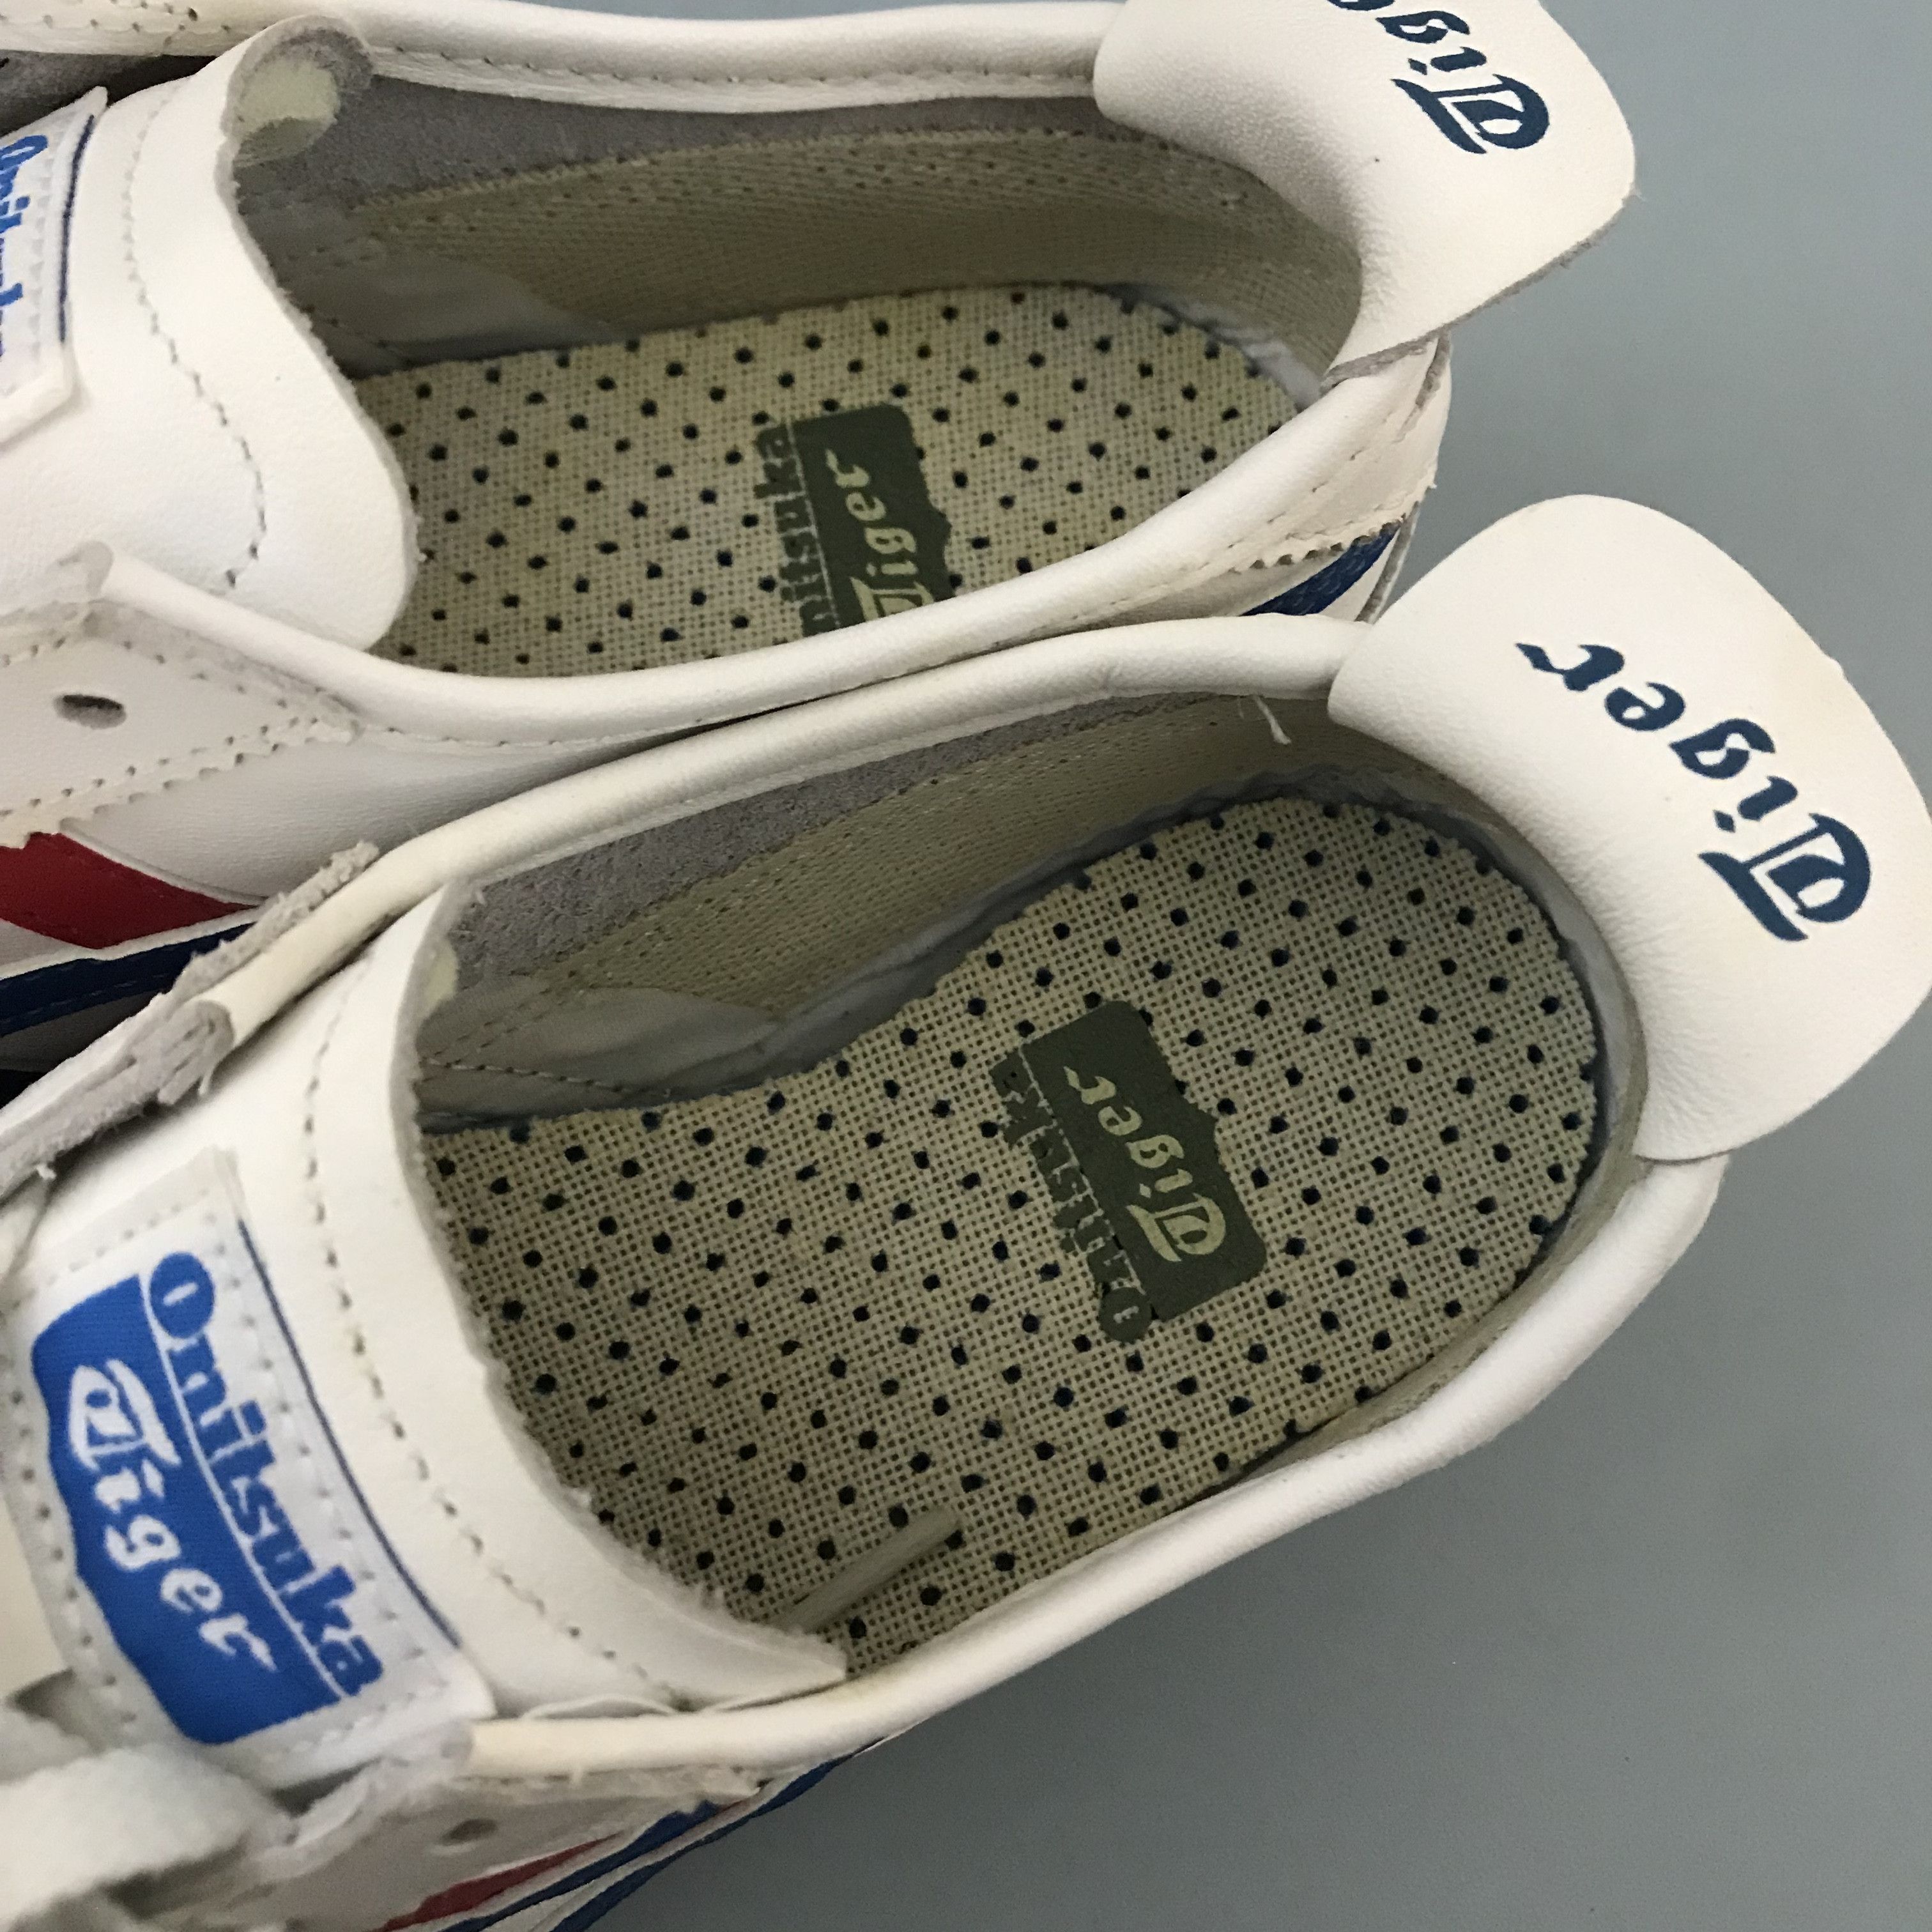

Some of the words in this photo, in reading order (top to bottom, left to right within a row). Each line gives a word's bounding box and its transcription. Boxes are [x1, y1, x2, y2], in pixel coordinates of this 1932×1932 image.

[825, 449, 935, 622] Tiger
[1515, 643, 1871, 942] Tiger
[1062, 1066, 1226, 1262] Tiger
[69, 1358, 276, 1672] Tiger
[149, 1252, 383, 1698] Onitsuka
